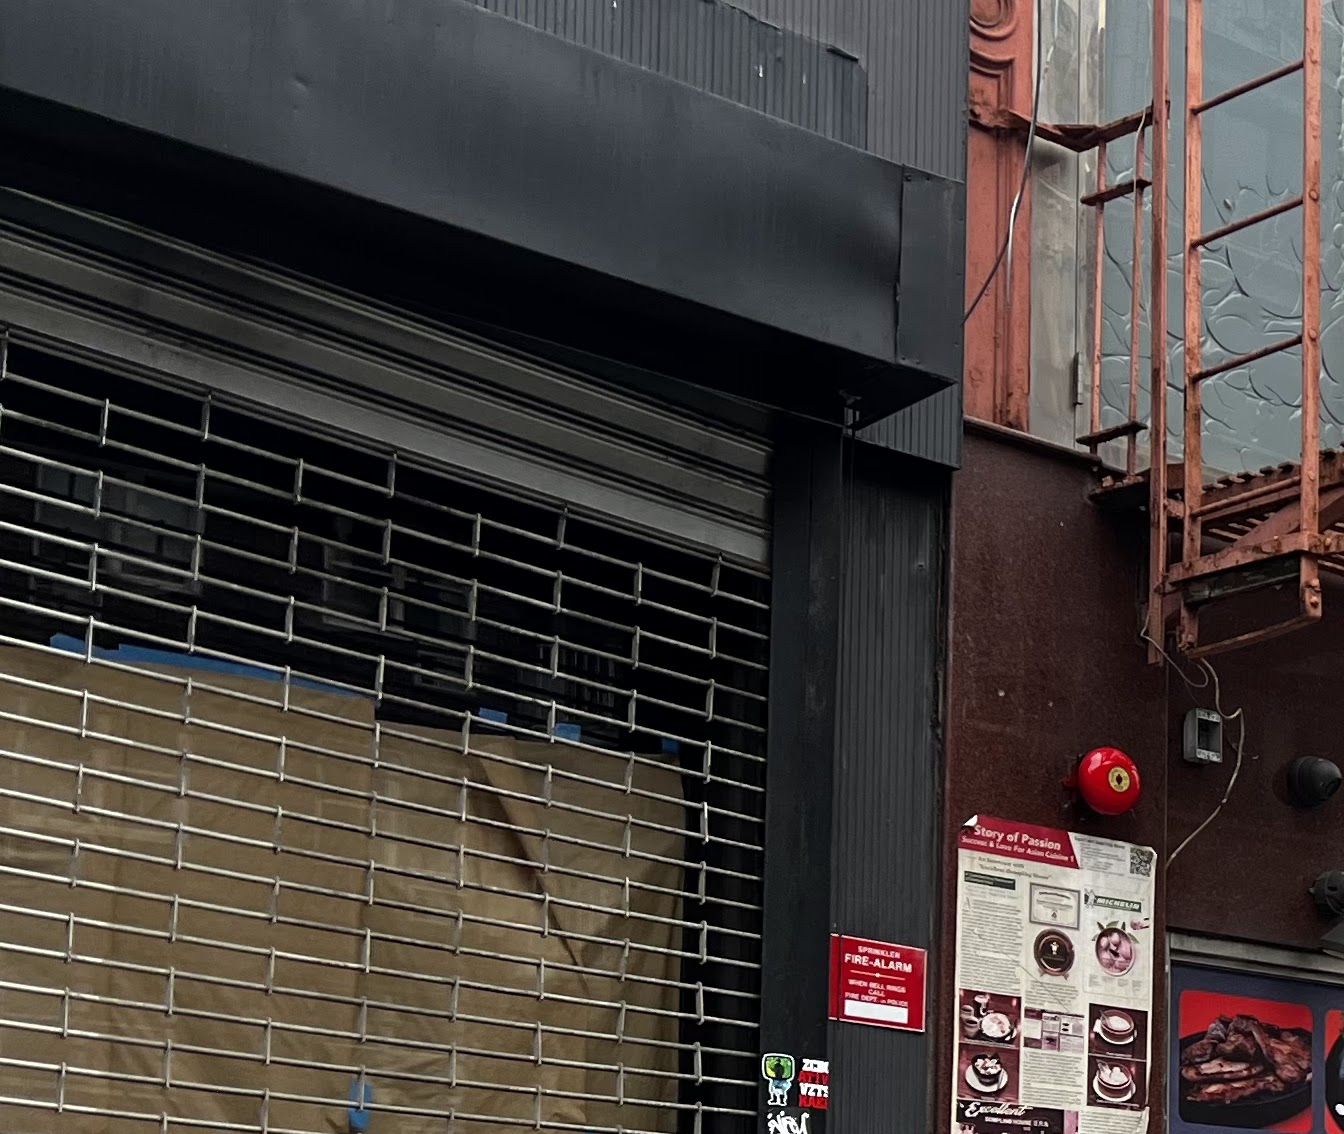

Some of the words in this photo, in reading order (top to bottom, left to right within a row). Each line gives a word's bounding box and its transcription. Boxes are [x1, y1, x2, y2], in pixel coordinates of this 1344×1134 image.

[973, 824, 1005, 843] Story
[1006, 832, 1019, 842] of
[1021, 834, 1061, 851] Passion
[844, 953, 912, 973] FIRE-ALARM
